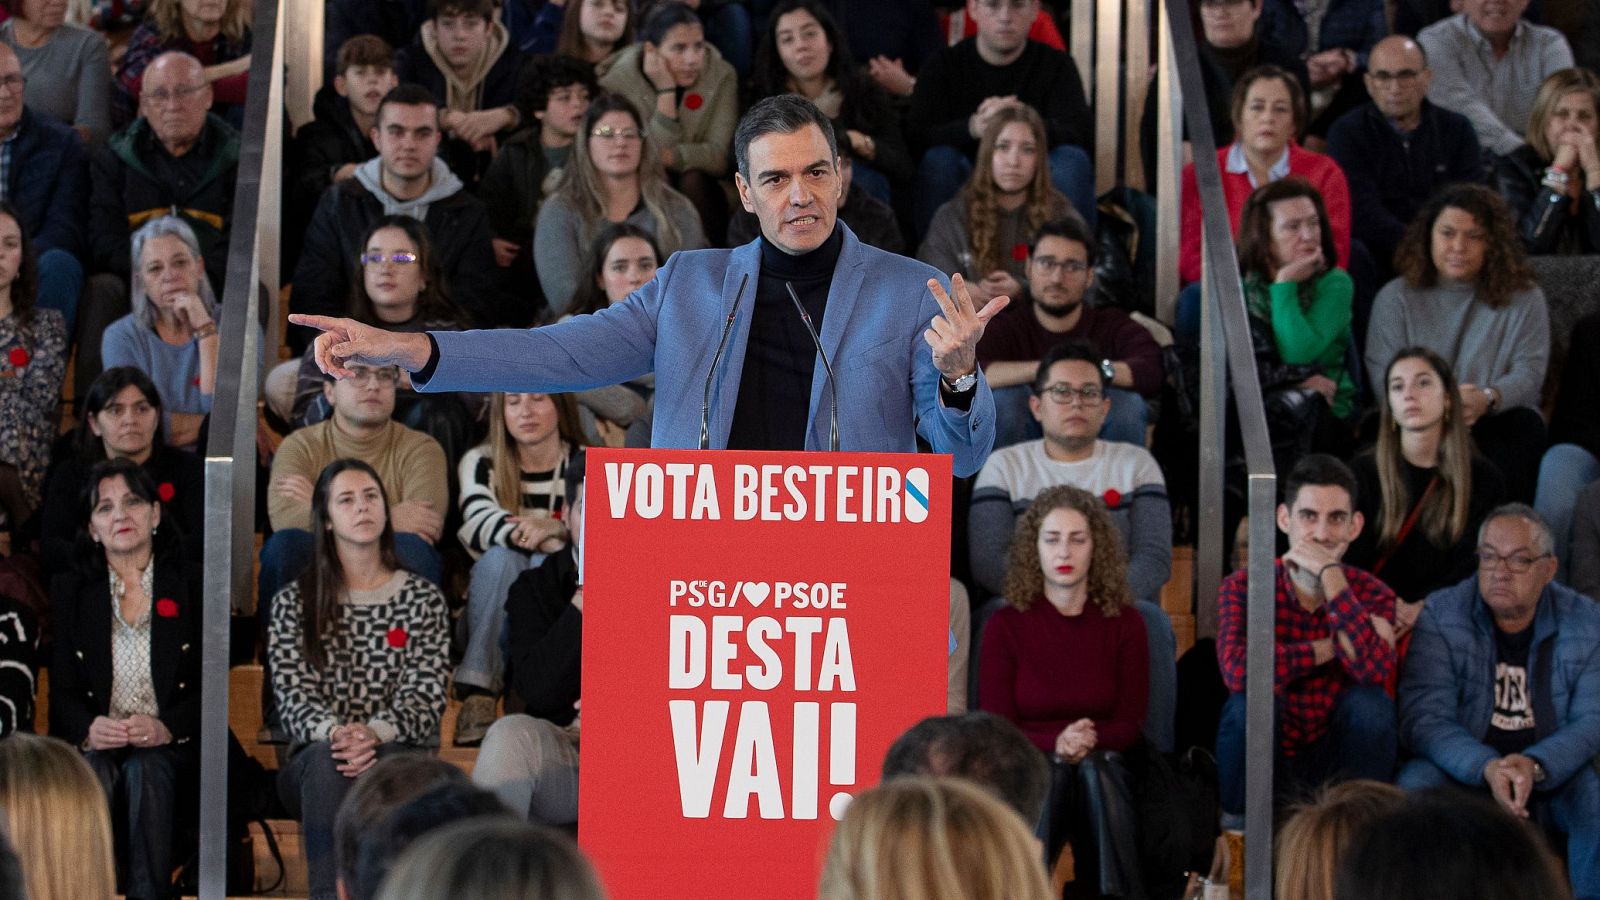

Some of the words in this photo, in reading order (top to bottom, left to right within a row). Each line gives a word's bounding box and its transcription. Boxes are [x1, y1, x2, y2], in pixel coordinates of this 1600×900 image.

[605, 462, 720, 519] VOTA
[734, 465, 929, 523] BESTEIRO
[774, 582, 847, 609] PSOE
[669, 615, 856, 691] DESTA
[669, 700, 856, 820] VAI!
